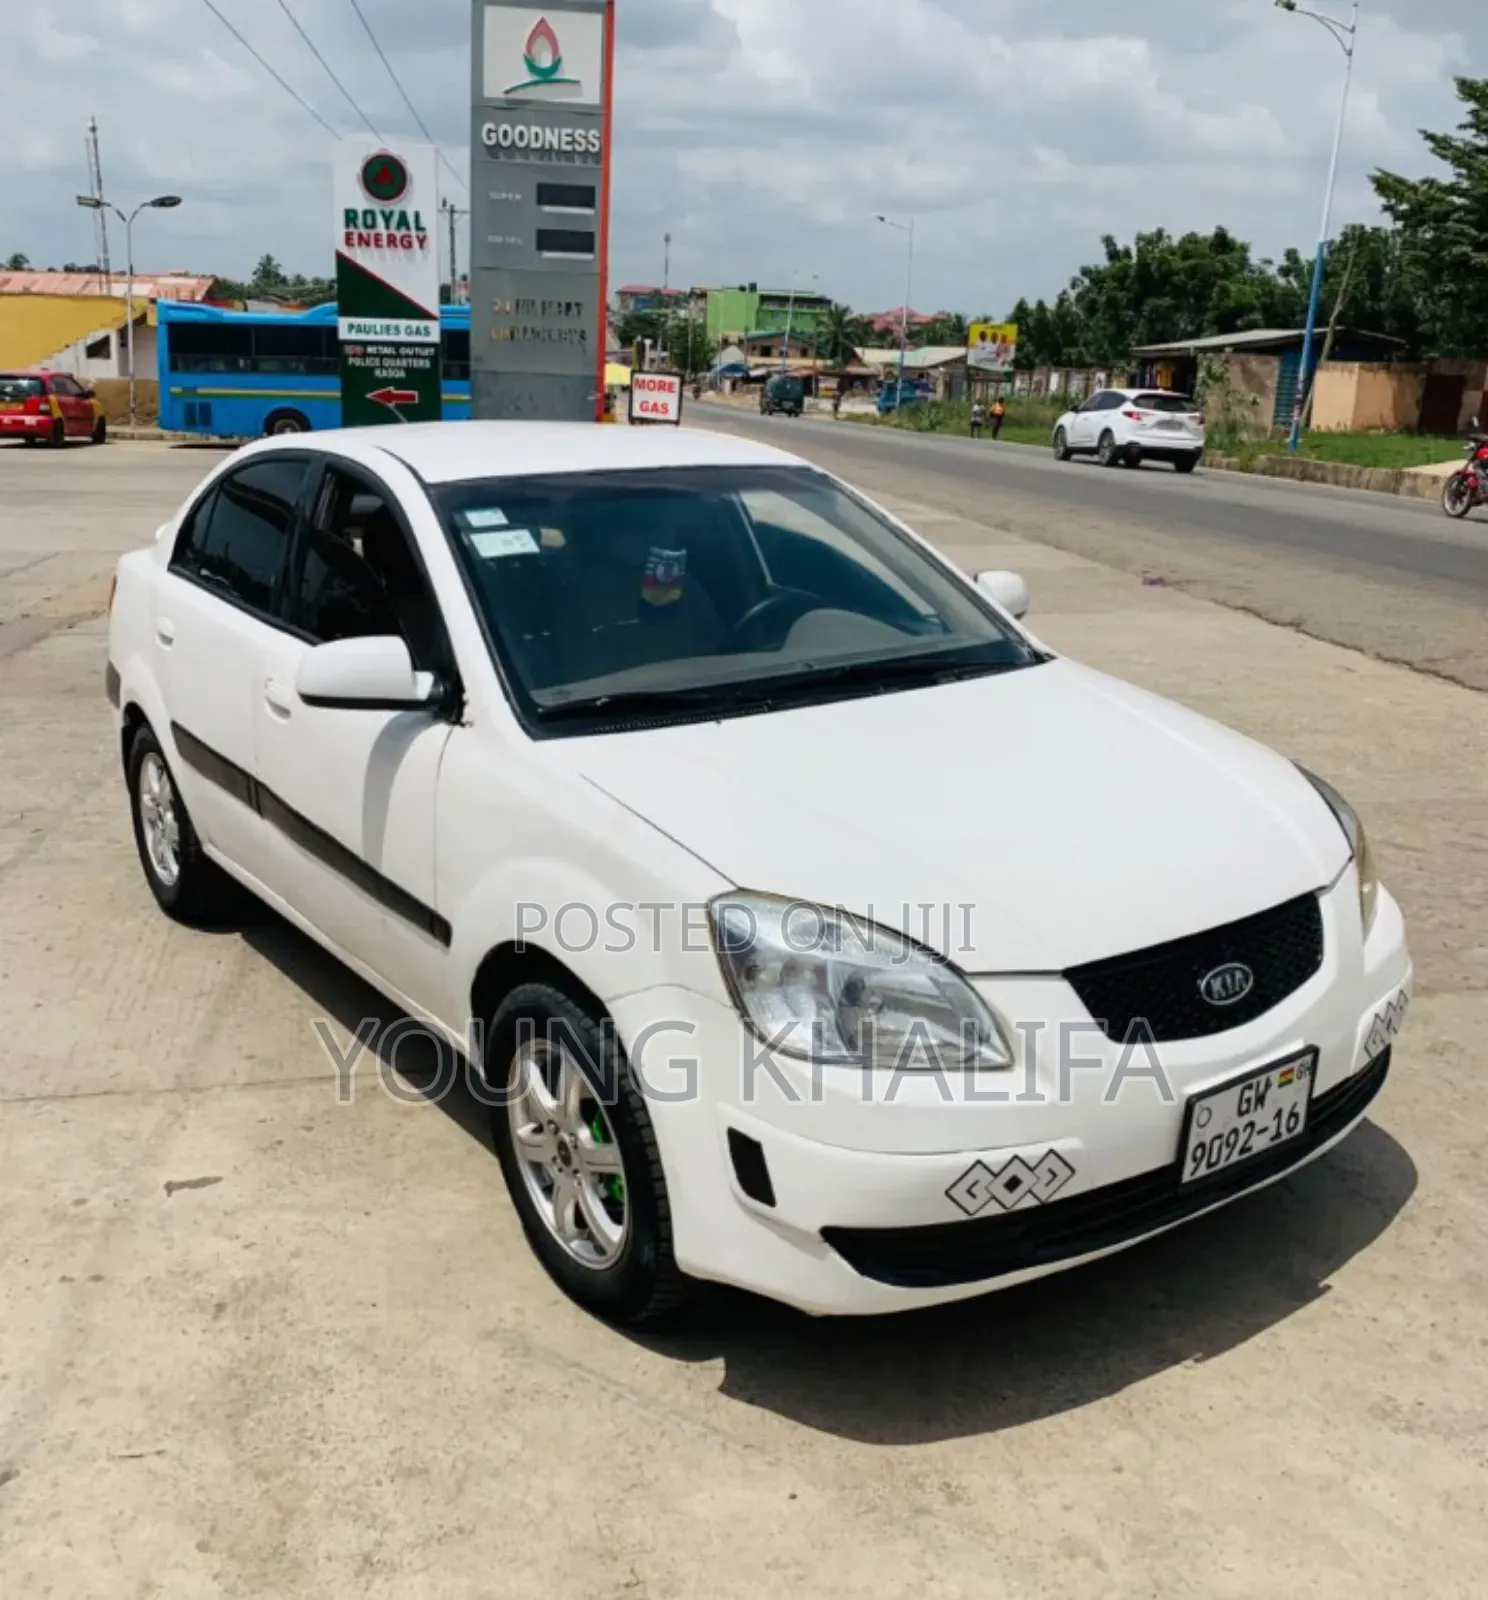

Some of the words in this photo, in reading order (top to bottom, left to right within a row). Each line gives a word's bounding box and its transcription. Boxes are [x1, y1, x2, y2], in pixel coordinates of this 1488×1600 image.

[482, 122, 601, 153] GOODNESS
[344, 208, 427, 232] ROYAL
[344, 231, 429, 250] ENERGY
[347, 322, 402, 336] PAULIES
[404, 324, 432, 337] GAS
[366, 344, 397, 356] RETAIL
[399, 346, 436, 357] OUTLET
[348, 356, 381, 367] POLICE
[382, 357, 431, 369] QUARTERS
[374, 368, 406, 379] KASOA
[633, 377, 676, 394] MORE
[639, 400, 669, 415] GAS
[1209, 969, 1249, 1000] KIA
[1237, 1075, 1273, 1117] GW
[1190, 1101, 1300, 1178] 9092-16
